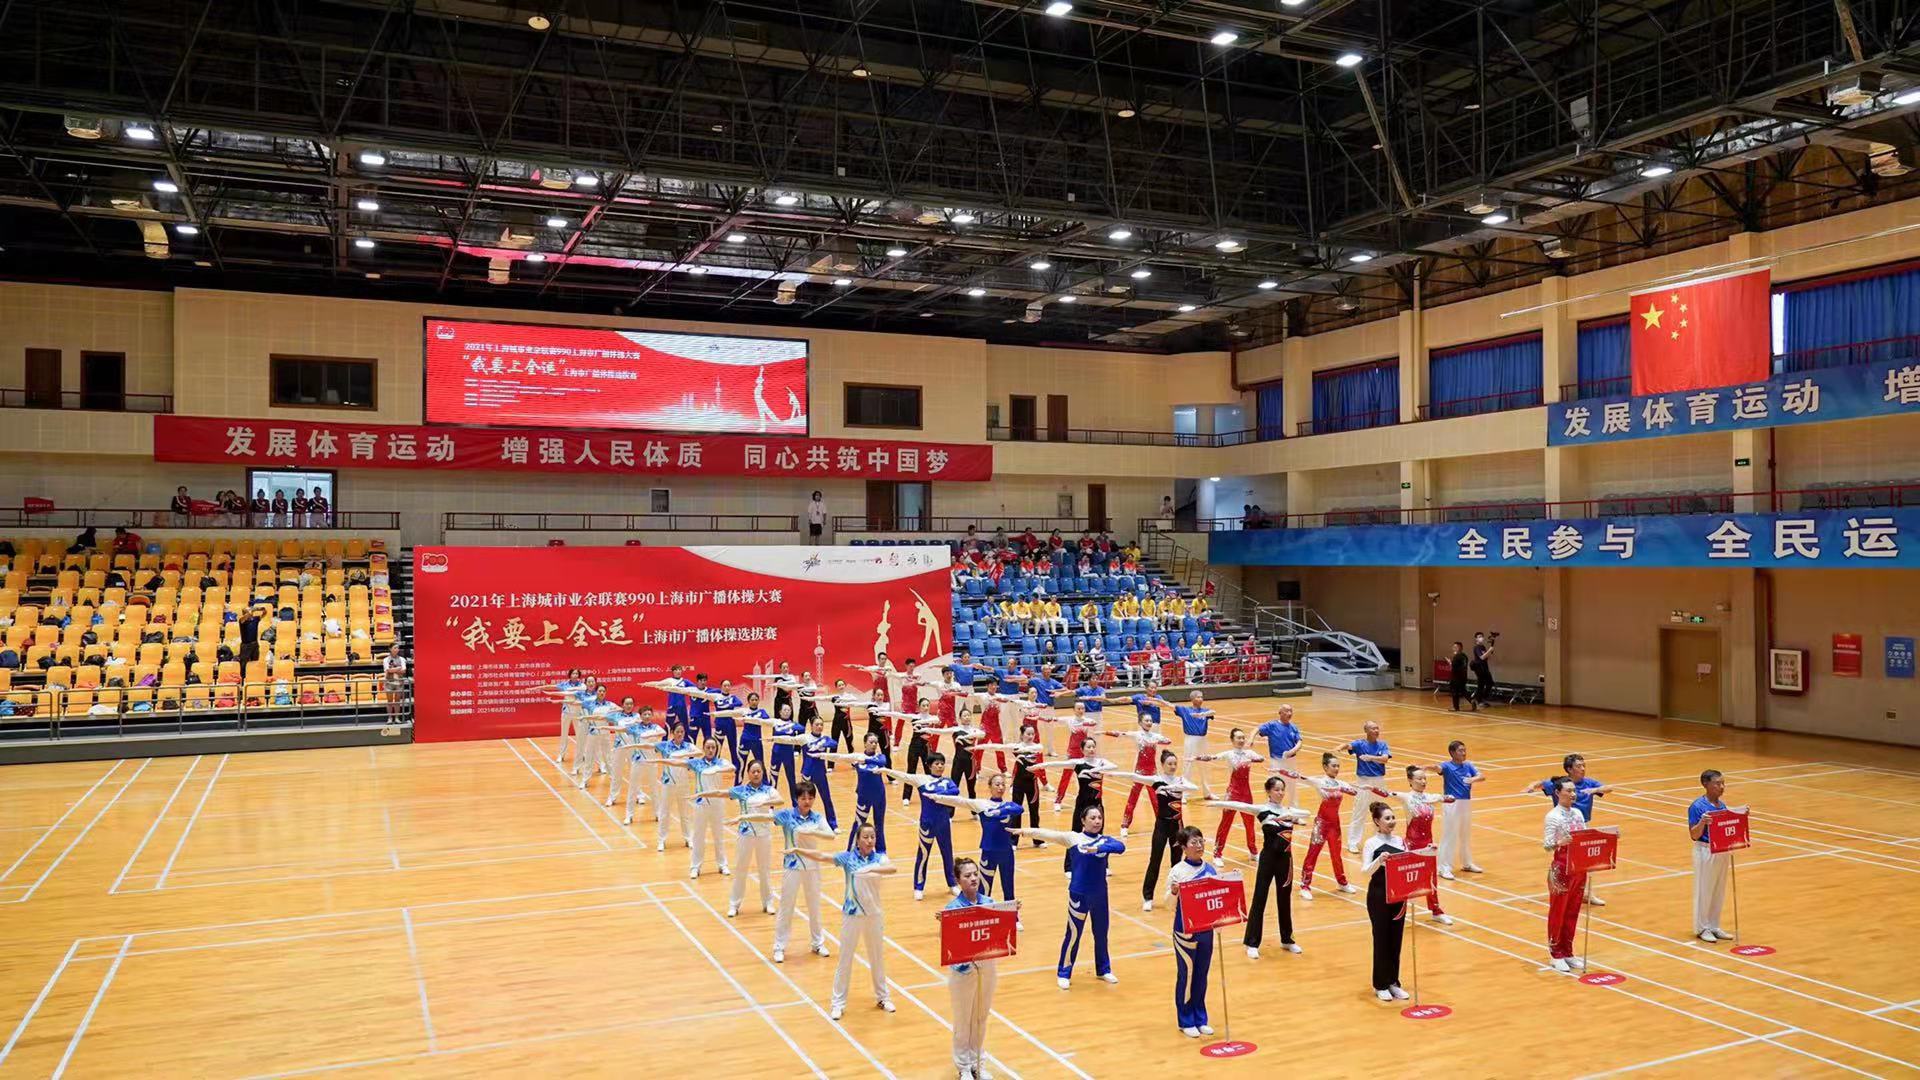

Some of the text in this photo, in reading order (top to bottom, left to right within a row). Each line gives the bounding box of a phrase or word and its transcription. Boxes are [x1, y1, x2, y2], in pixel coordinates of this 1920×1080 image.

[1564, 379, 1820, 438] 发展体育运动
[225, 426, 949, 475] 发展体育运动 增强人民体质 同心共筑中国梦
[1457, 518, 1899, 561] 全民参与 全民运
[450, 589, 783, 609] 2021年上海城市业余联赛990上海市广播体操大赛
[639, 626, 778, 645] 上海市广播体操选拔赛
[1587, 846, 1601, 857] 08
[1406, 870, 1419, 882] 07
[1206, 896, 1224, 911] 06
[971, 927, 991, 942] 05
